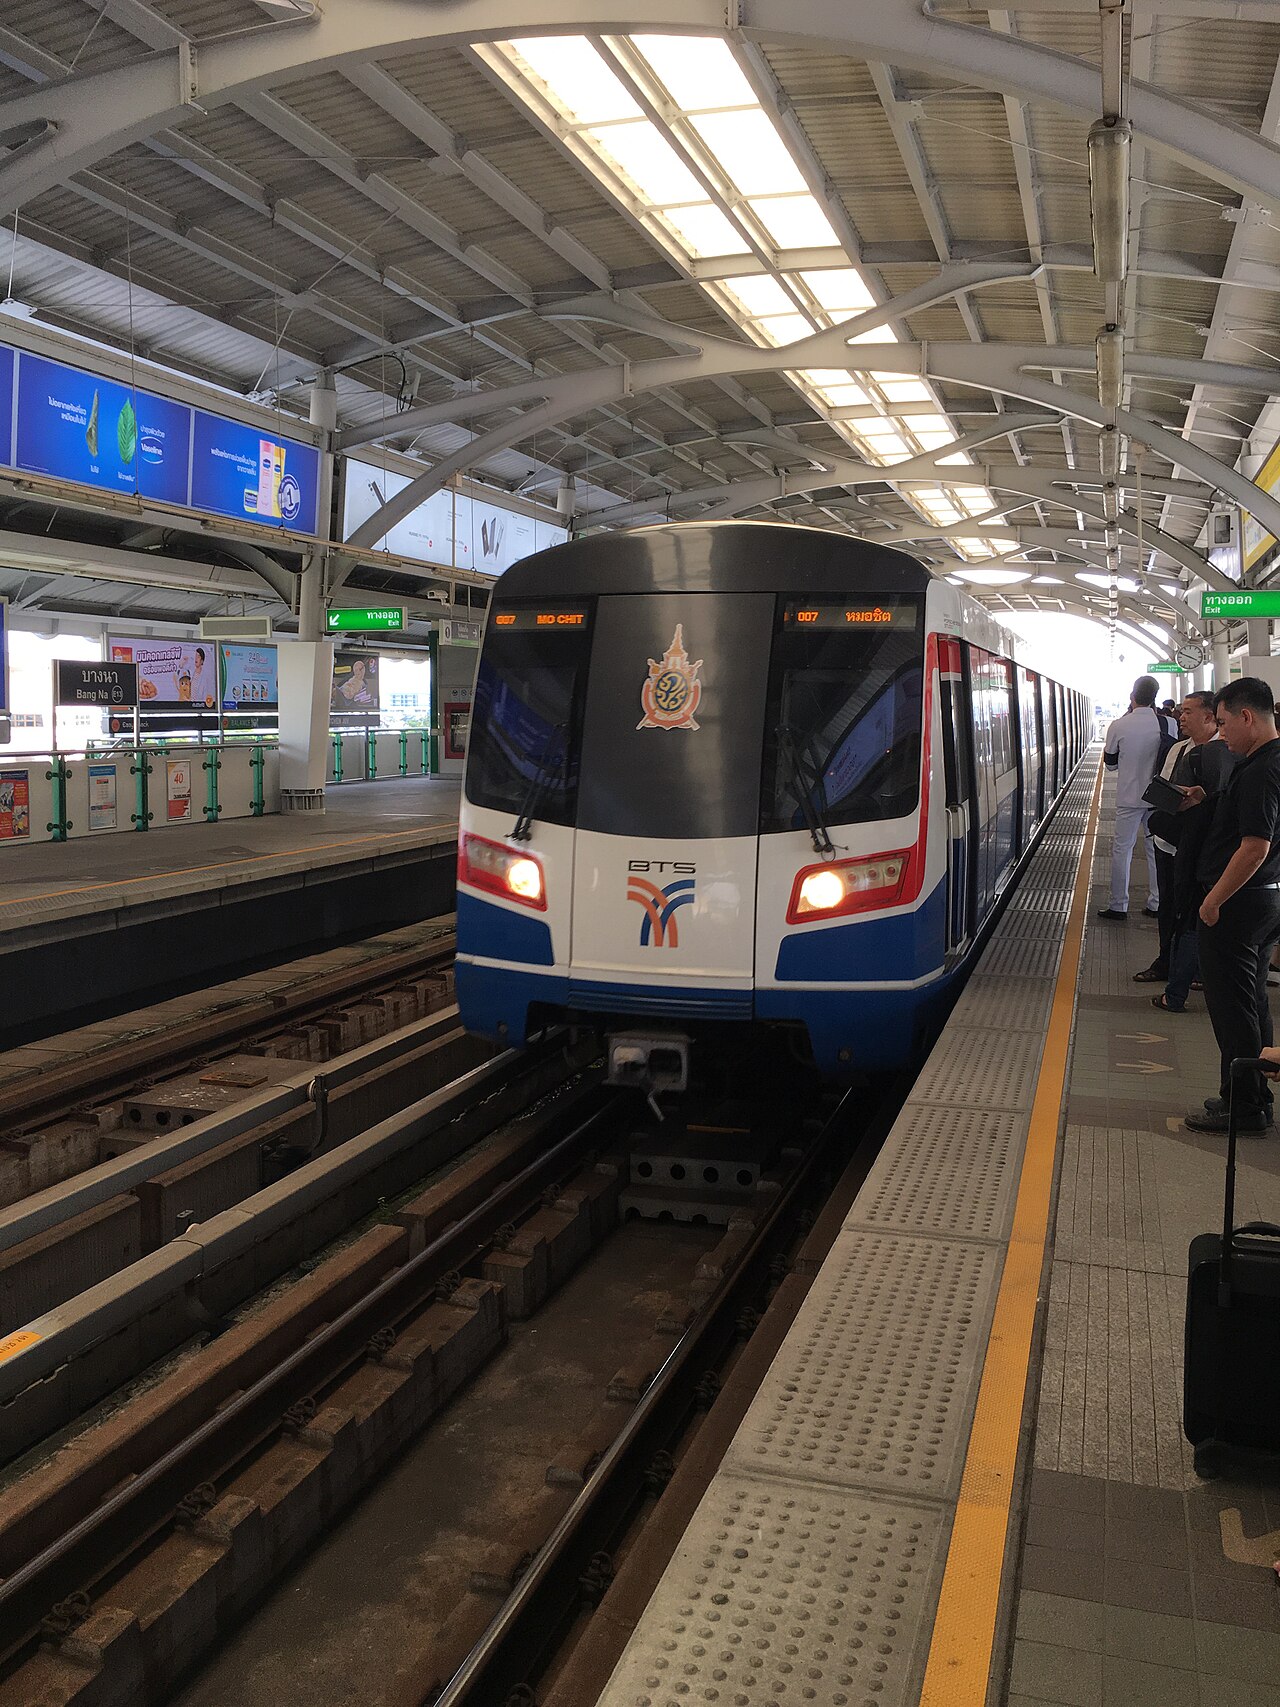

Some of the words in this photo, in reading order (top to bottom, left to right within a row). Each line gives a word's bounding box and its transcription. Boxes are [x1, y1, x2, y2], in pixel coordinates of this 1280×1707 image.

[141, 442, 163, 456] Vaseline
[1205, 596, 1253, 605] ทางออก
[366, 611, 400, 620] ทางออก
[845, 607, 892, 622] หมอชิต
[1204, 606, 1221, 614] Exit
[536, 615, 556, 625] MO
[557, 614, 584, 624] CHIT
[797, 611, 819, 622] 007
[82, 670, 119, 684] บางนา
[76, 688, 97, 700] Bang
[98, 688, 109, 700] Na
[122, 721, 134, 730] Easy
[174, 773, 184, 784] 40
[628, 860, 697, 874] BTS
